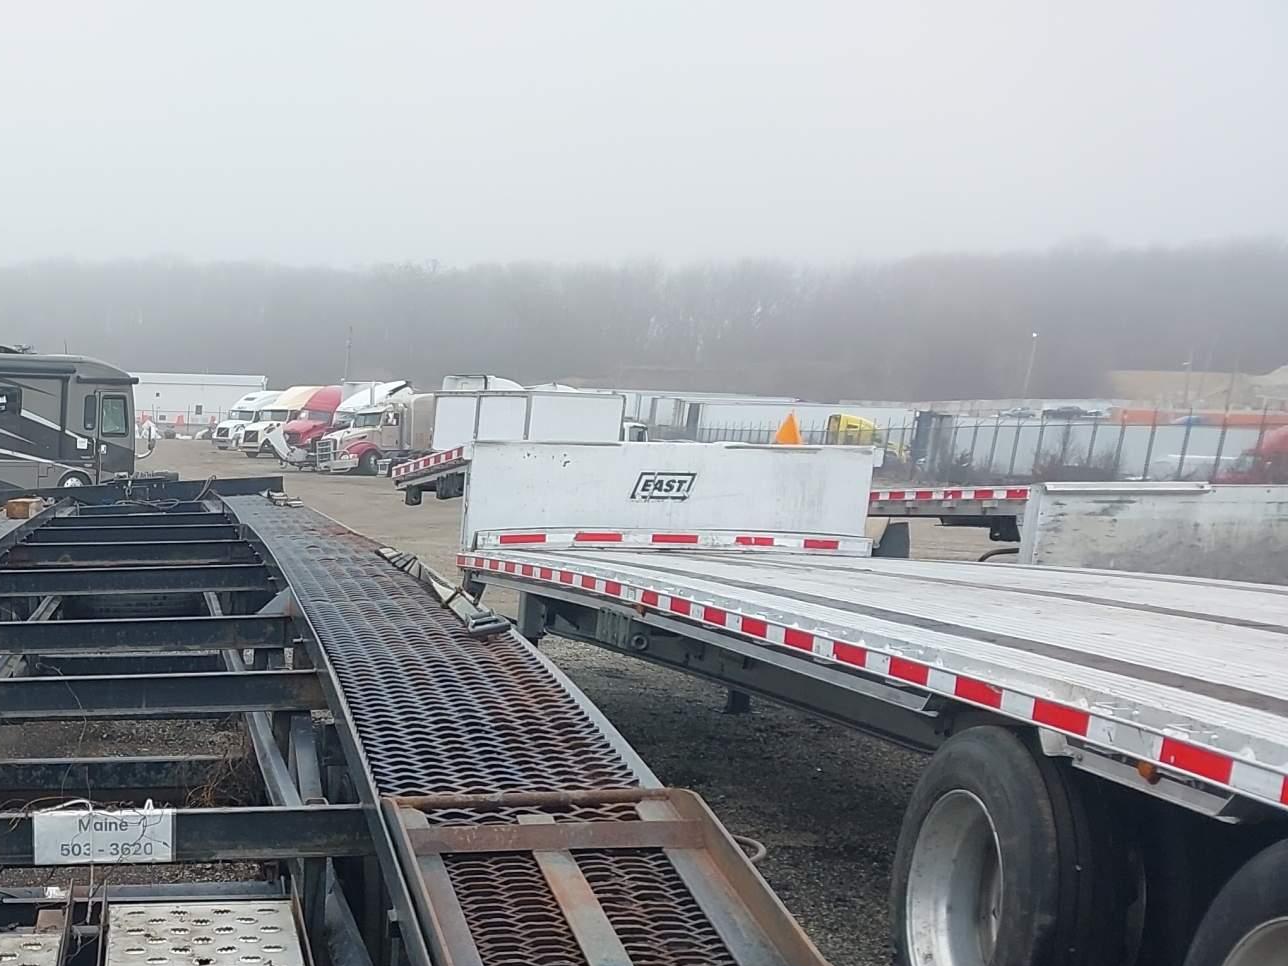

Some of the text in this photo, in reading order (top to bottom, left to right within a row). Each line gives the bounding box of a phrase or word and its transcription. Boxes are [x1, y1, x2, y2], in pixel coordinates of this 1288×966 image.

[641, 479, 688, 493] EAST
[78, 818, 129, 833] Maine
[60, 842, 91, 857] 503
[109, 842, 153, 856] 3620
